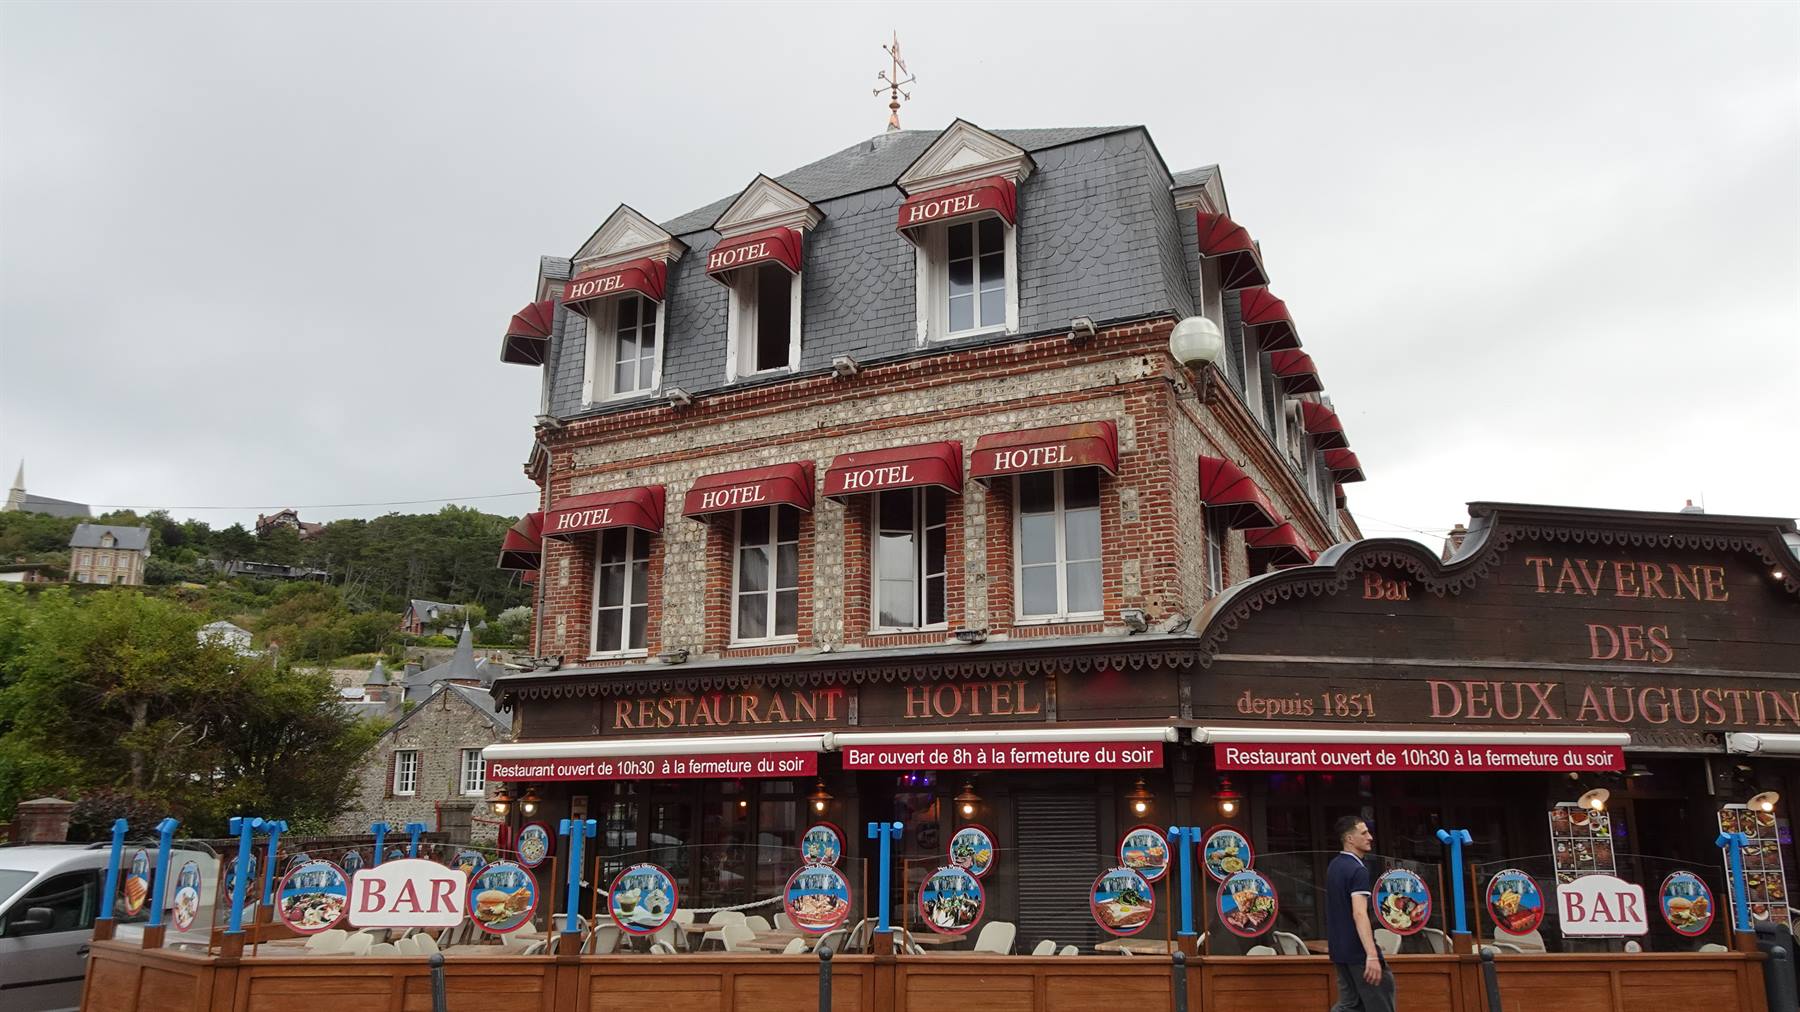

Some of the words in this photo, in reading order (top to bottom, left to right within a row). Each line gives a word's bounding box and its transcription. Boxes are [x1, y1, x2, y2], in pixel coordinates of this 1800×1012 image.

[908, 193, 980, 222] HOTEL
[708, 241, 770, 269] HOTEL
[569, 274, 625, 299] HOTEL
[994, 444, 1073, 471] HOTEL
[842, 465, 915, 490] HOTEL
[700, 484, 766, 509] HOTEL
[556, 508, 613, 530] HOTEL
[1362, 572, 1409, 601] Bar
[1525, 555, 1729, 601] TAVERNE
[1585, 623, 1674, 664] DES
[612, 687, 842, 730] RESTAURANT
[904, 680, 1041, 718] HOTEL
[1237, 688, 1314, 719] depuis
[1321, 692, 1376, 718] 1851
[1426, 679, 1562, 720] DEUX
[1576, 685, 1800, 727] AUGUSTIN
[492, 763, 555, 777] Restaurant
[557, 764, 595, 776] ouvert
[597, 761, 613, 776] de
[617, 760, 655, 775] 10h30
[661, 758, 670, 774] à
[674, 759, 685, 774] la
[688, 759, 752, 774] fermeture
[757, 757, 775, 773] du
[778, 757, 805, 772] soir
[849, 749, 875, 765] Bar
[878, 750, 925, 765] ouvert
[929, 749, 949, 764] de
[953, 748, 972, 764] 8h
[977, 747, 987, 764] à
[991, 748, 1006, 764] la
[1010, 747, 1090, 764] fermeture
[1095, 746, 1116, 763] du
[1121, 746, 1154, 763] soir
[1226, 747, 1317, 765] Restaurant
[1320, 750, 1373, 765] ouvert
[1376, 749, 1396, 765] de
[1401, 749, 1450, 765] 10h30
[1454, 749, 1464, 766] à
[1468, 750, 1483, 766] la
[1486, 750, 1559, 766] fermeture
[1563, 750, 1583, 766] du
[1586, 750, 1614, 766] soir
[358, 878, 459, 913] BAR
[1562, 891, 1642, 923] BAR
